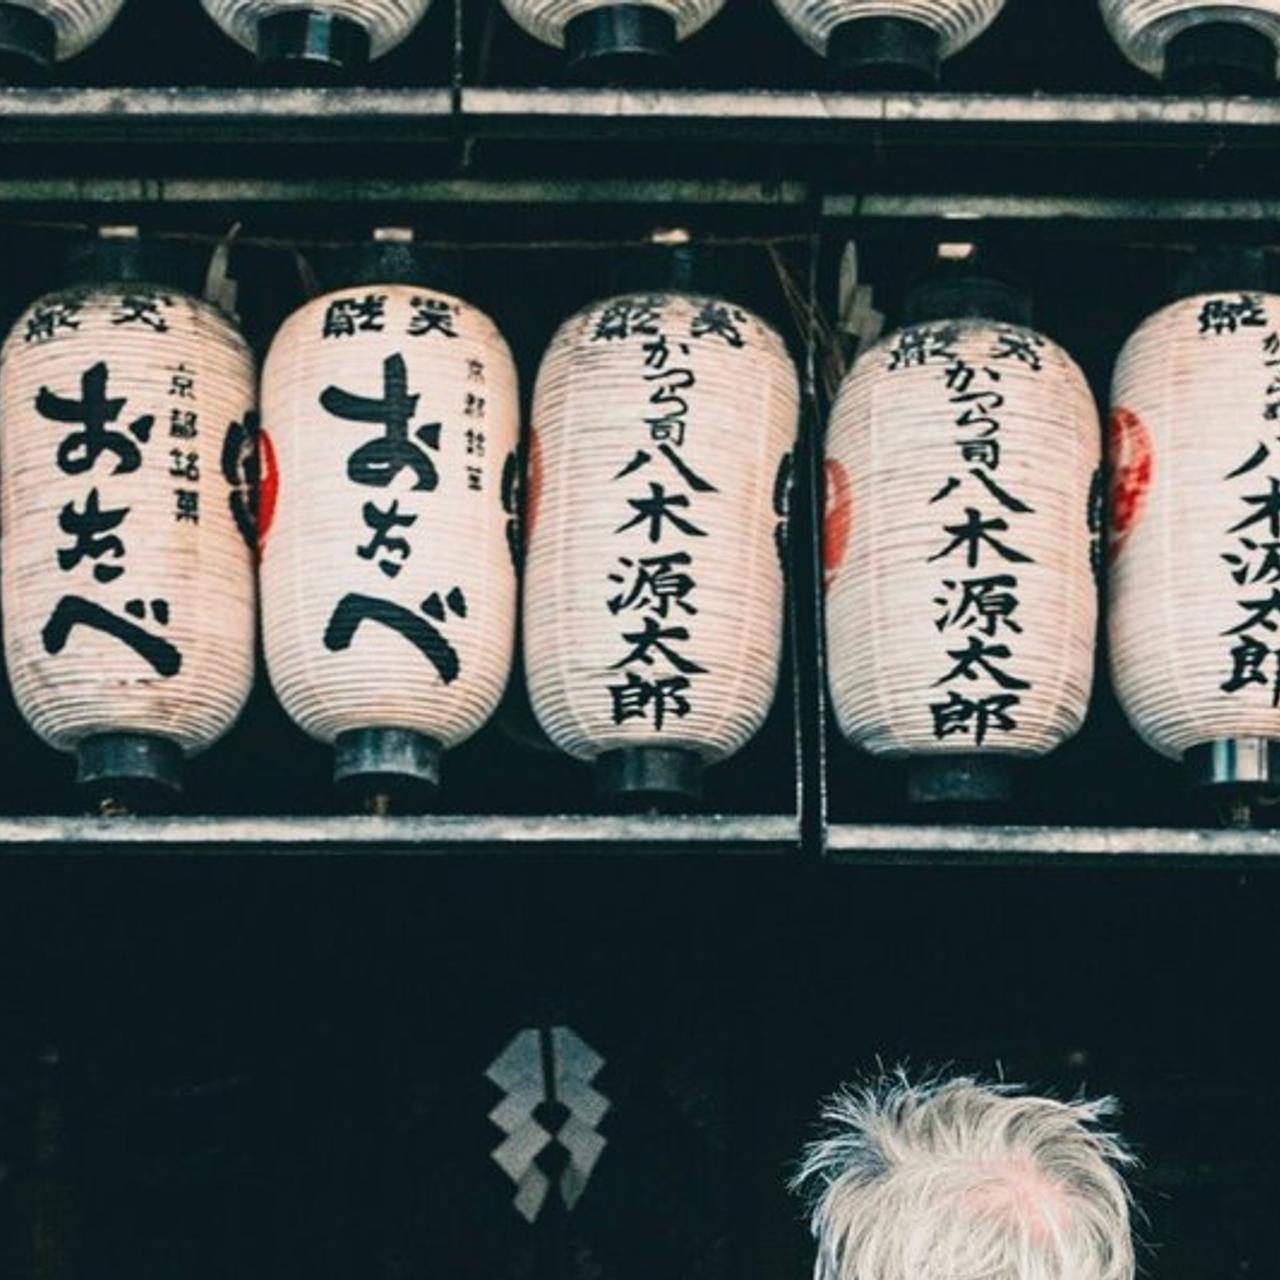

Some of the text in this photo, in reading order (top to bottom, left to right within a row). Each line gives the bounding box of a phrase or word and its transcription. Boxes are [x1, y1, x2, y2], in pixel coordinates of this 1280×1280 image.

[34, 362, 183, 678] おたべ
[319, 352, 468, 685] おたべ
